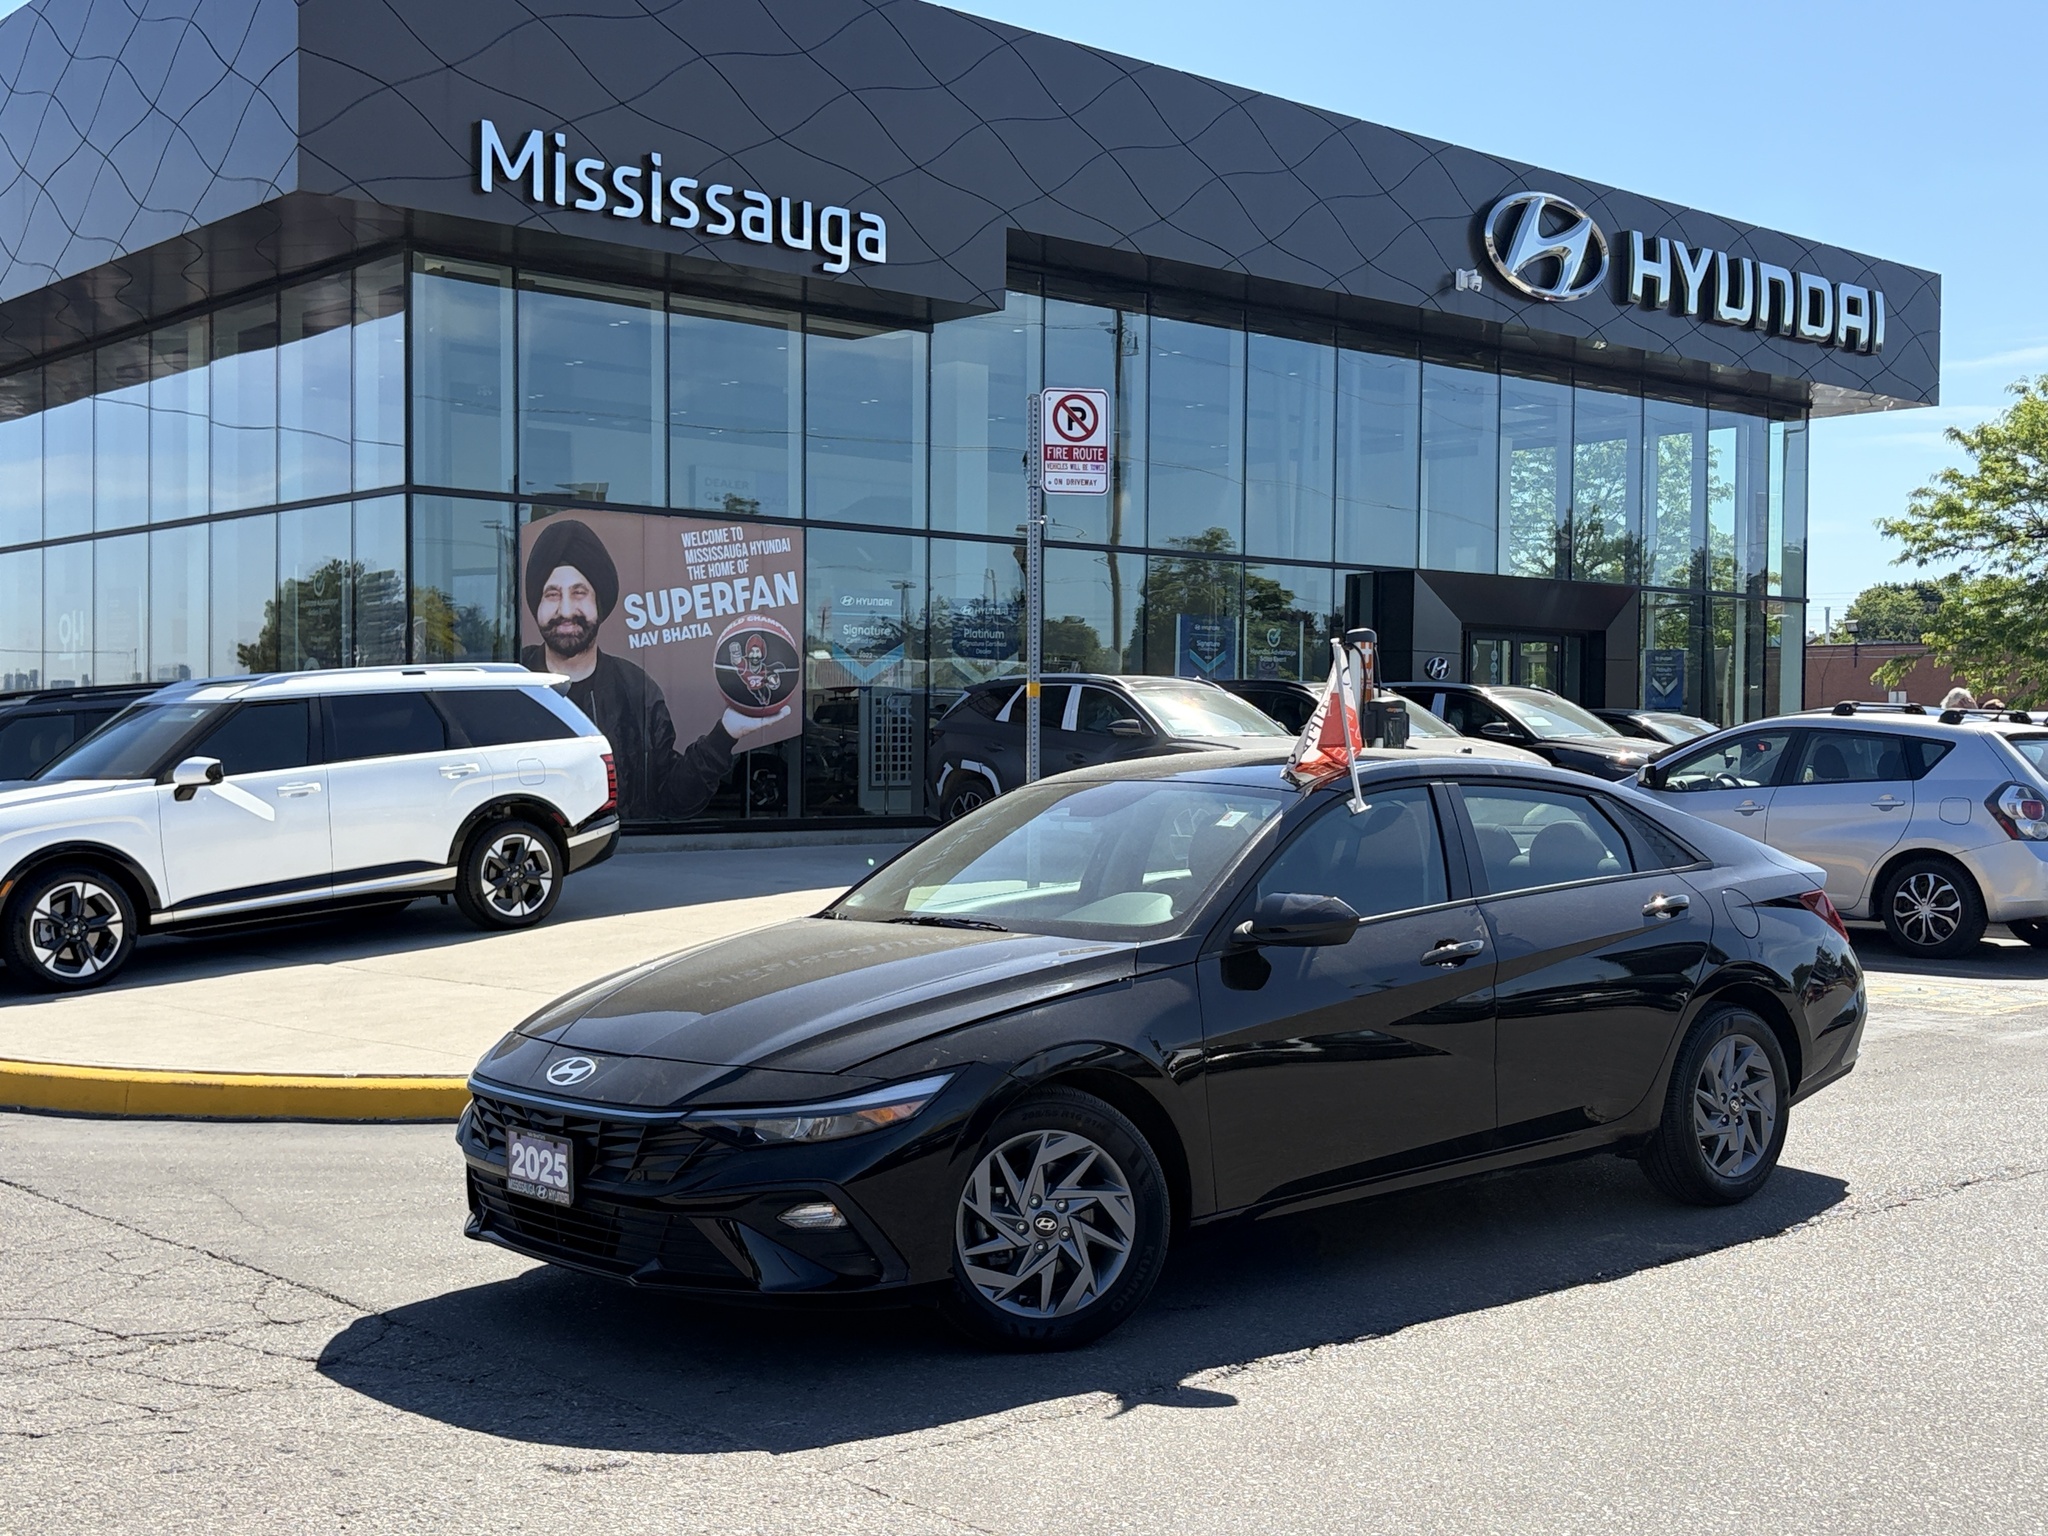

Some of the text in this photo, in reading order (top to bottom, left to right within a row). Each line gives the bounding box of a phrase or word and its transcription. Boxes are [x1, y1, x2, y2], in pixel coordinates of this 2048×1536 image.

[480, 119, 887, 274] Mississauga
[1628, 229, 1887, 356] HYUNDAI
[1046, 446, 1104, 461] FIRE ROUTE
[1046, 462, 1068, 470] VEHICLES
[1070, 463, 1081, 471] WILL
[1082, 463, 1088, 471] BE
[704, 476, 750, 490] DEALER
[1053, 478, 1097, 486] ON DRIVEWAY
[681, 526, 744, 548] WELCOME TO
[684, 537, 792, 564] MISSISSAUGA HYUNDAI
[686, 558, 749, 581] THE HOME OF
[624, 571, 799, 630] SUPERFAN
[855, 597, 894, 607] HYUNDAI
[974, 607, 1009, 615] HYUNDAI
[628, 622, 713, 649] NAV BHATIA
[842, 624, 891, 637] Signature
[963, 628, 1005, 639] Platinum
[511, 1142, 569, 1188] 2025
[1110, 1245, 1155, 1312] KUMHO
